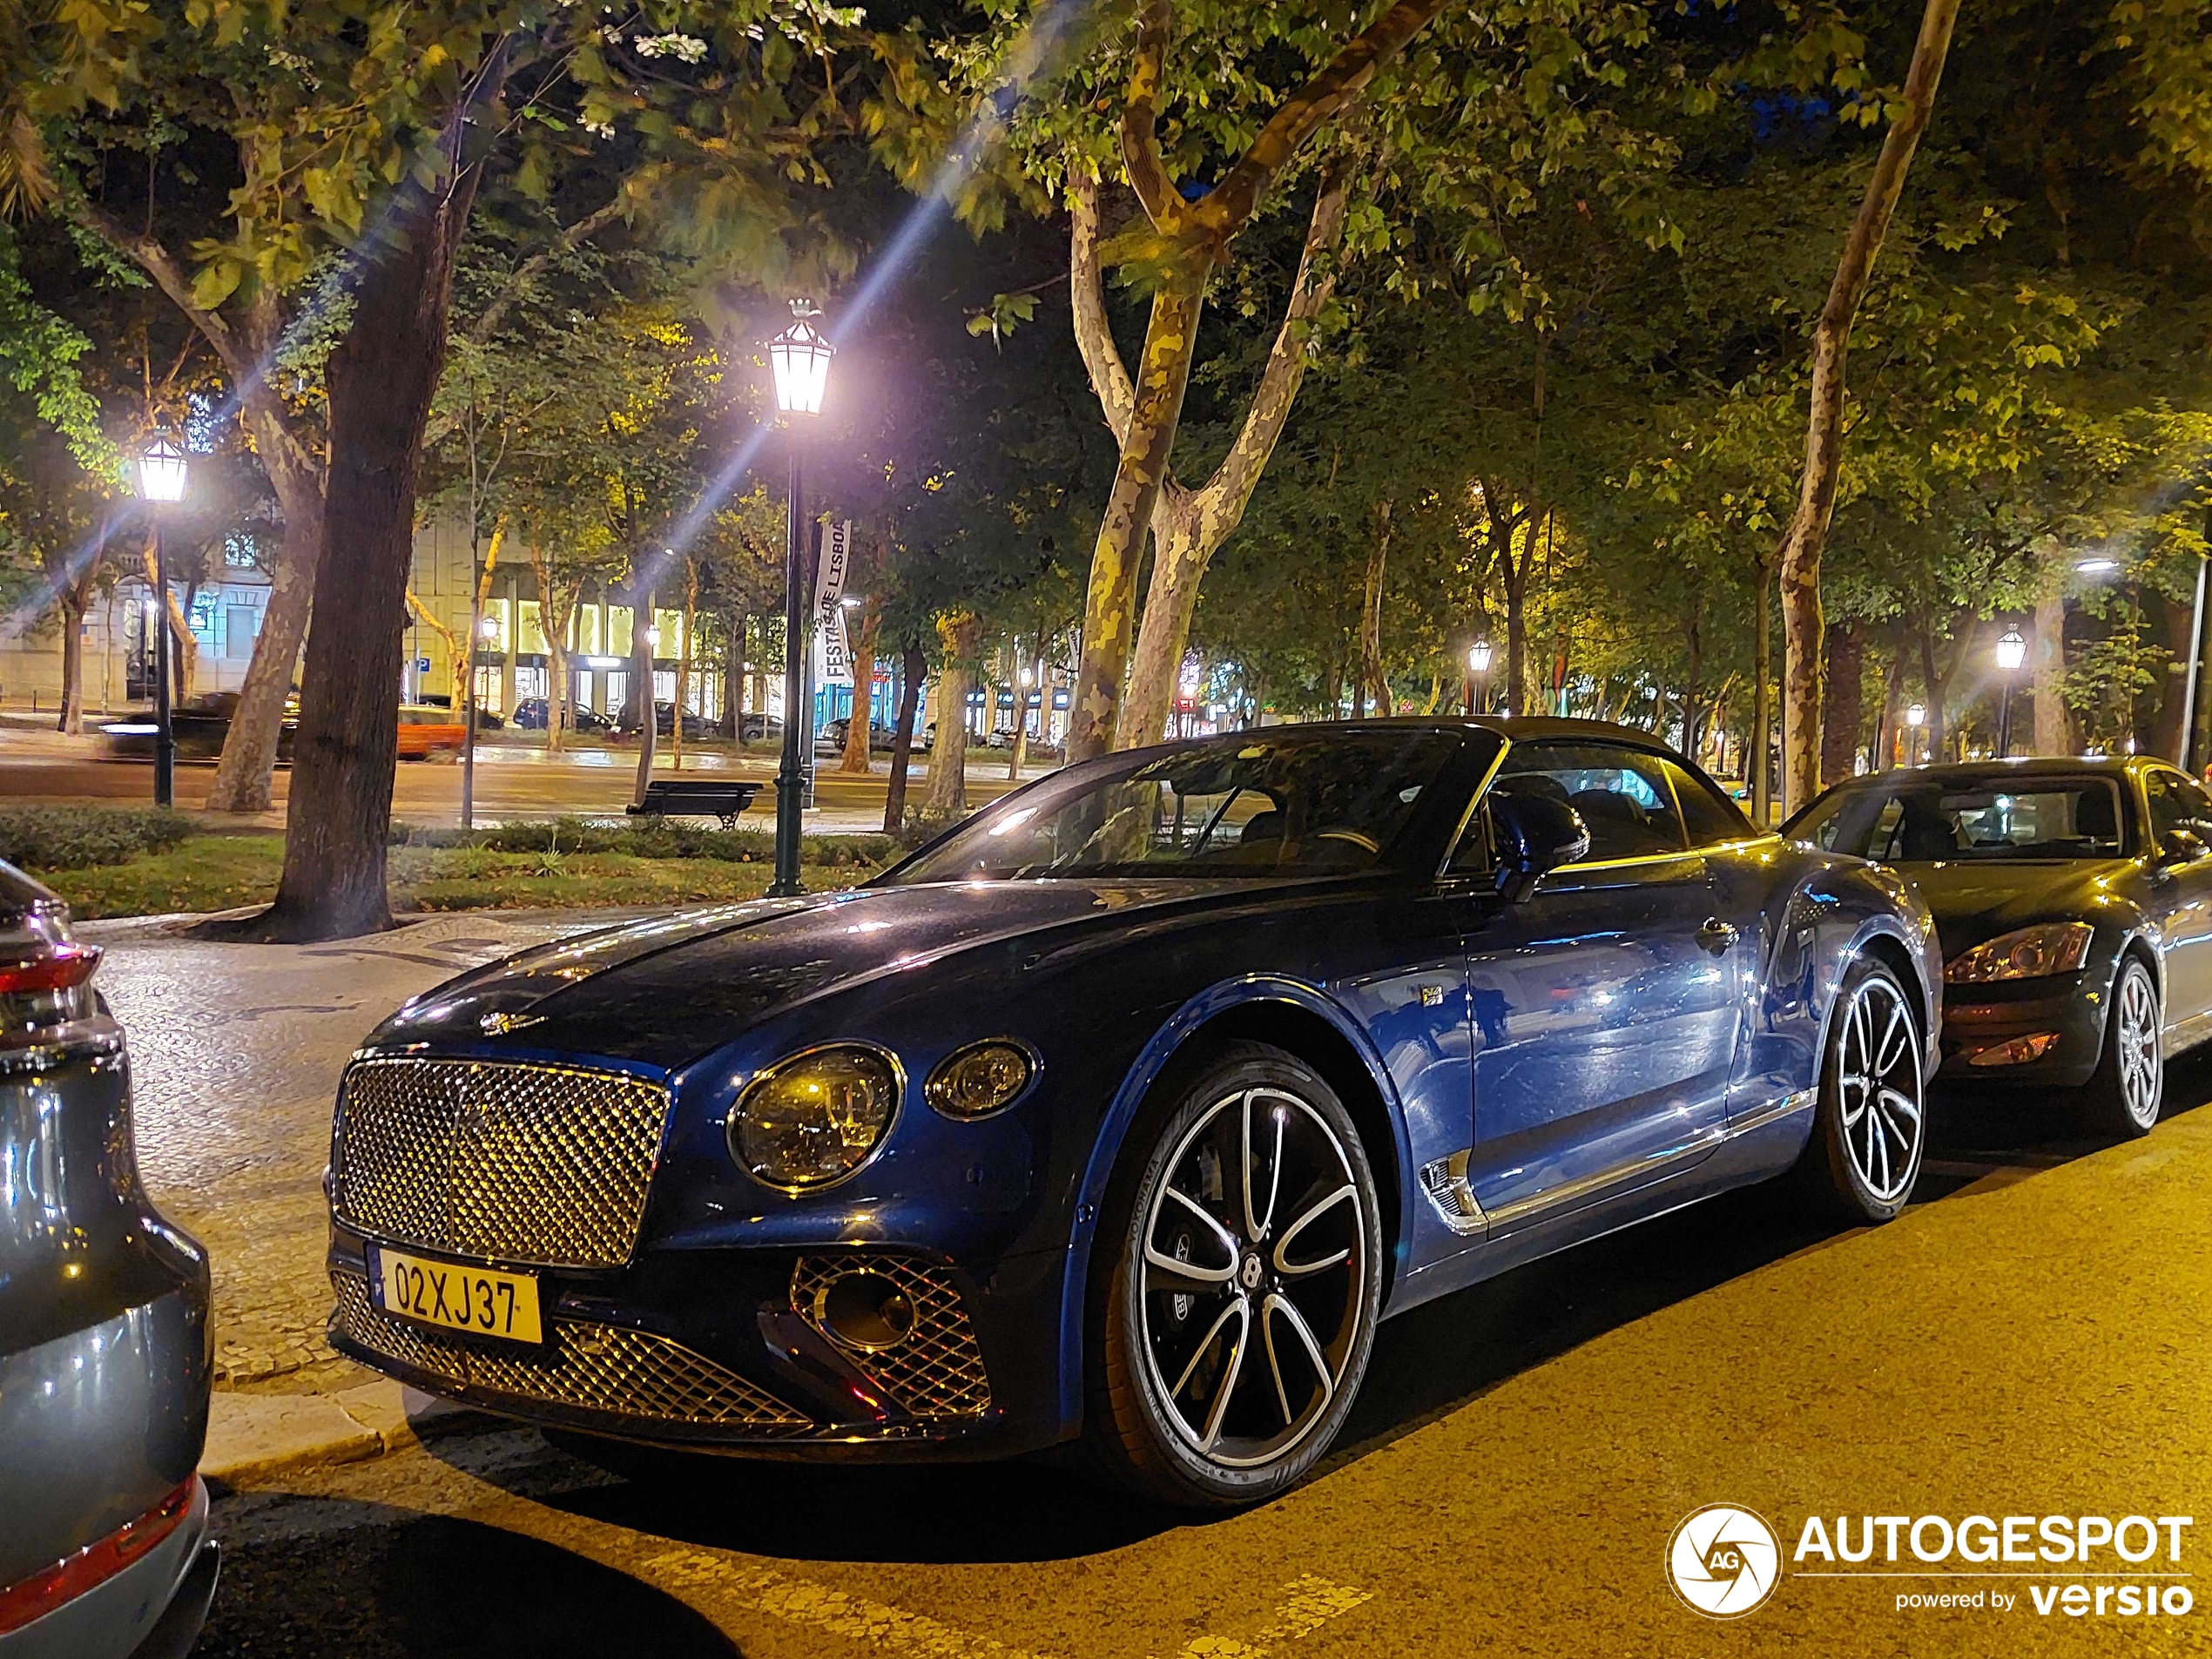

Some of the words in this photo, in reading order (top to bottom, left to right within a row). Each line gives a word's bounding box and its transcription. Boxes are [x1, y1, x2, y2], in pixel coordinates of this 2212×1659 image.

[827, 520, 845, 588] LISBOA
[821, 590, 836, 611] DE
[824, 615, 845, 678] FESTAS
[1129, 1159, 1160, 1243] YOKOHAMA
[395, 1262, 515, 1333] 02XJ37
